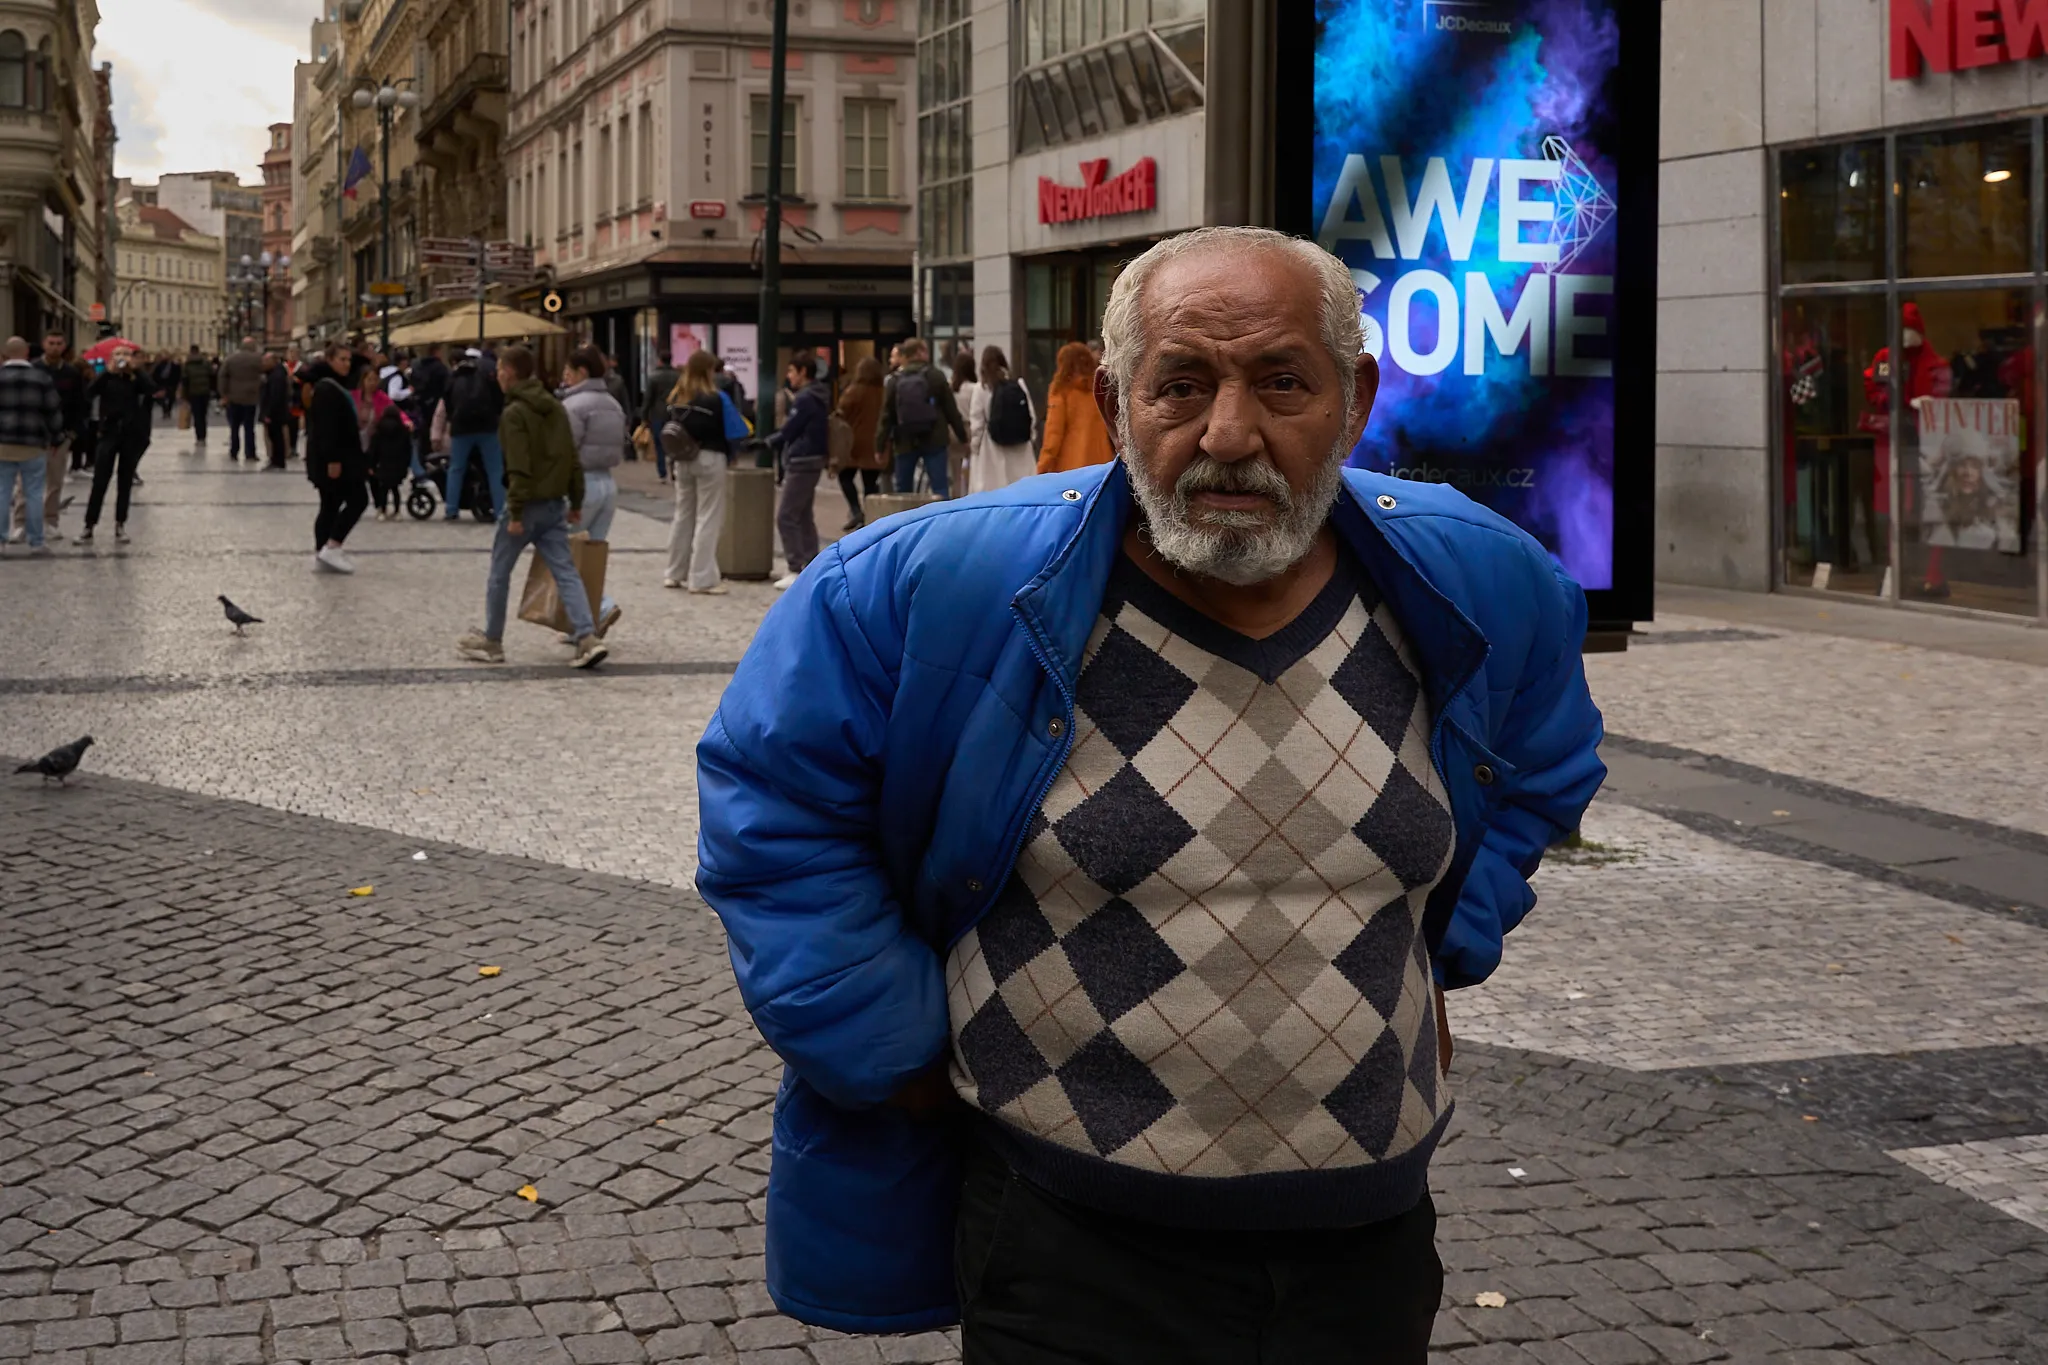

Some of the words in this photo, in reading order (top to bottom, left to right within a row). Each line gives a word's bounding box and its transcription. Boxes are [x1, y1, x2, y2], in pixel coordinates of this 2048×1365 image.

[1436, 15, 1511, 33] JCDecaux
[702, 102, 713, 184] HOTEL
[1317, 153, 1561, 262] AWE
[1920, 402, 2019, 436] WINTER
